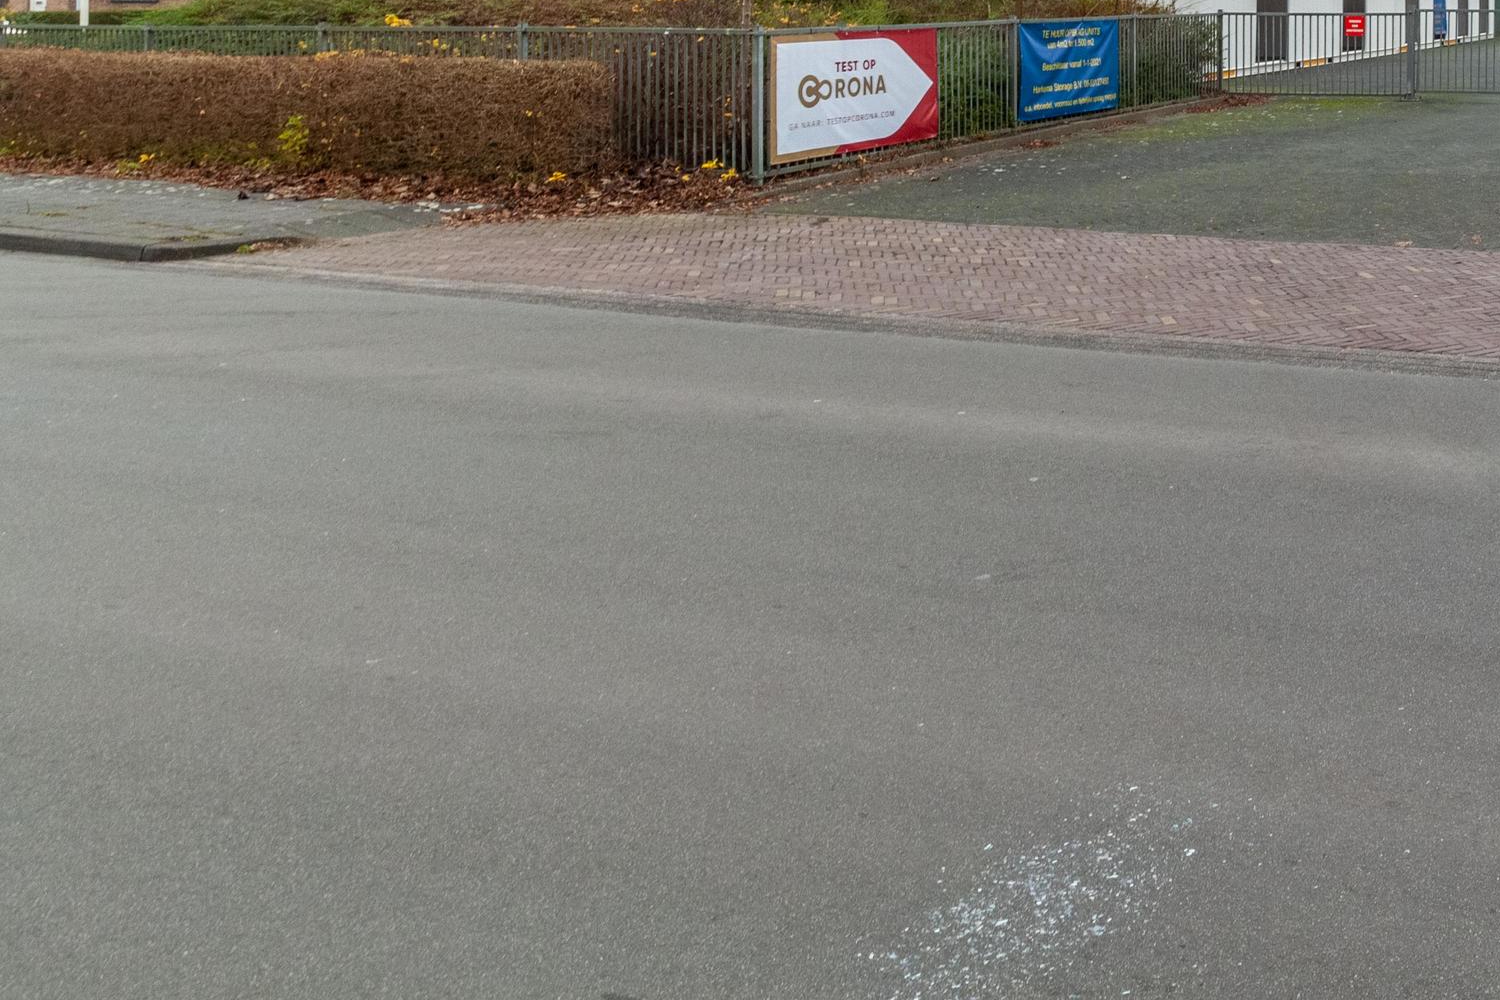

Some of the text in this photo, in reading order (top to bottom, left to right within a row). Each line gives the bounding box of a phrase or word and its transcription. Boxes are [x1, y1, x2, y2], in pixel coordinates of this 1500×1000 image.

[835, 59, 876, 72] TEST OP
[798, 74, 887, 108] CORONA
